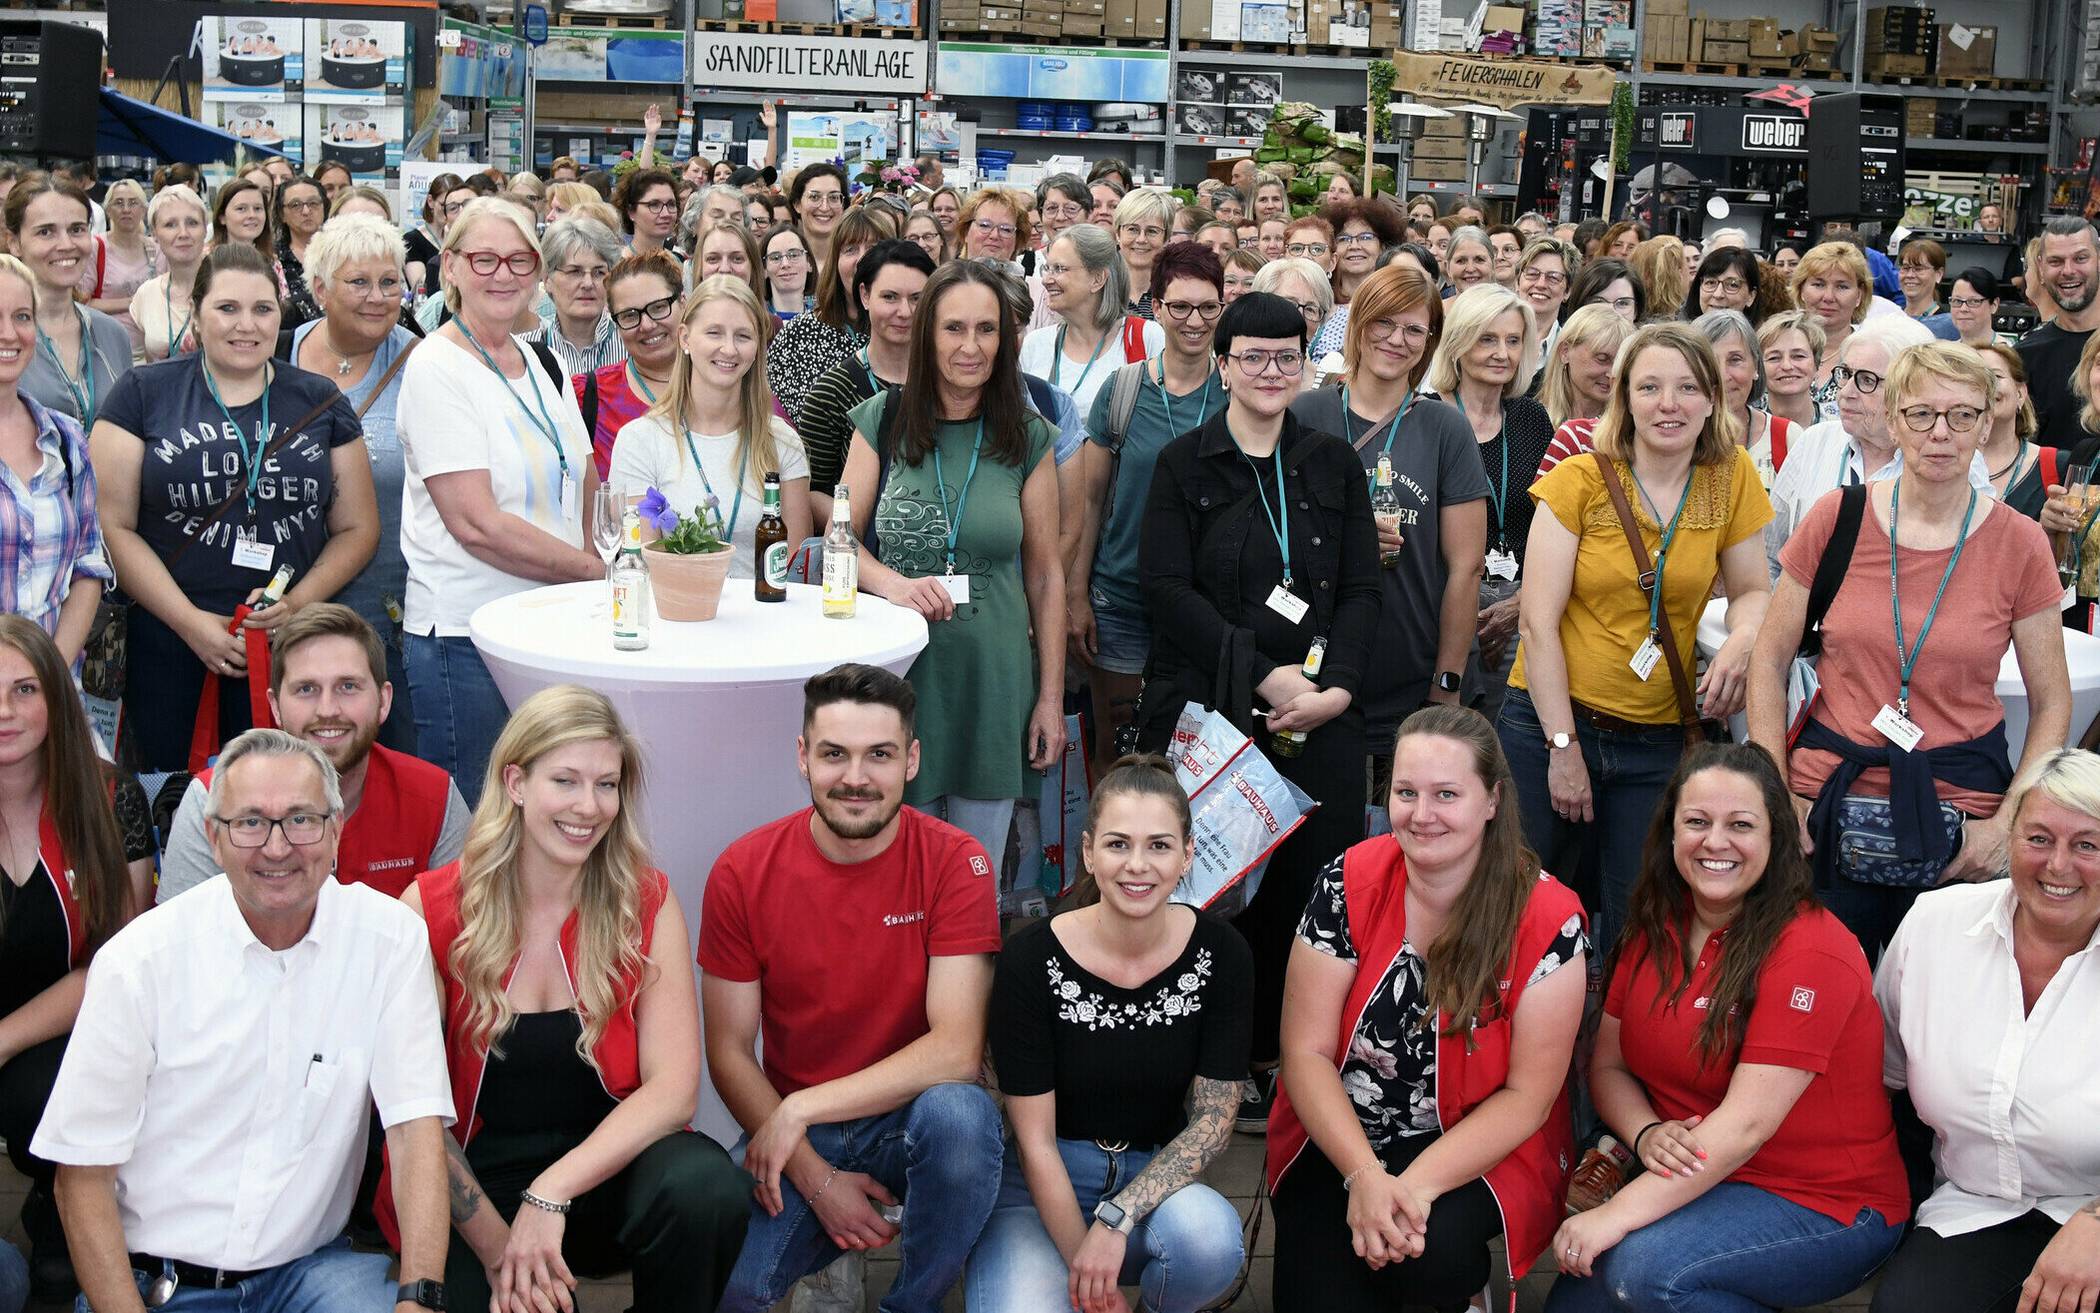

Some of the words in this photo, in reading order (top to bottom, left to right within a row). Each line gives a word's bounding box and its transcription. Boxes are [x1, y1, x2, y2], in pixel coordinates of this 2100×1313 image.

[706, 45, 914, 79] SANDFILTERANLAGE
[1439, 61, 1545, 89] FEUERSCHALEN
[1749, 116, 1805, 148] weber
[154, 421, 238, 465] MADE
[255, 420, 325, 463] WTH
[202, 450, 282, 478] LOE
[168, 476, 320, 508] HILFGER
[1398, 473, 1430, 506] SMILE
[165, 510, 258, 548] DENIM
[272, 504, 320, 544] NYC
[1236, 779, 1279, 834] BAUHAUS
[1195, 817, 1211, 835] Denn
[1219, 844, 1232, 860] Frau
[1199, 857, 1214, 874] muss.
[1206, 847, 1218, 860] was
[1215, 858, 1229, 873] eine
[889, 910, 924, 925] BAUHUS
